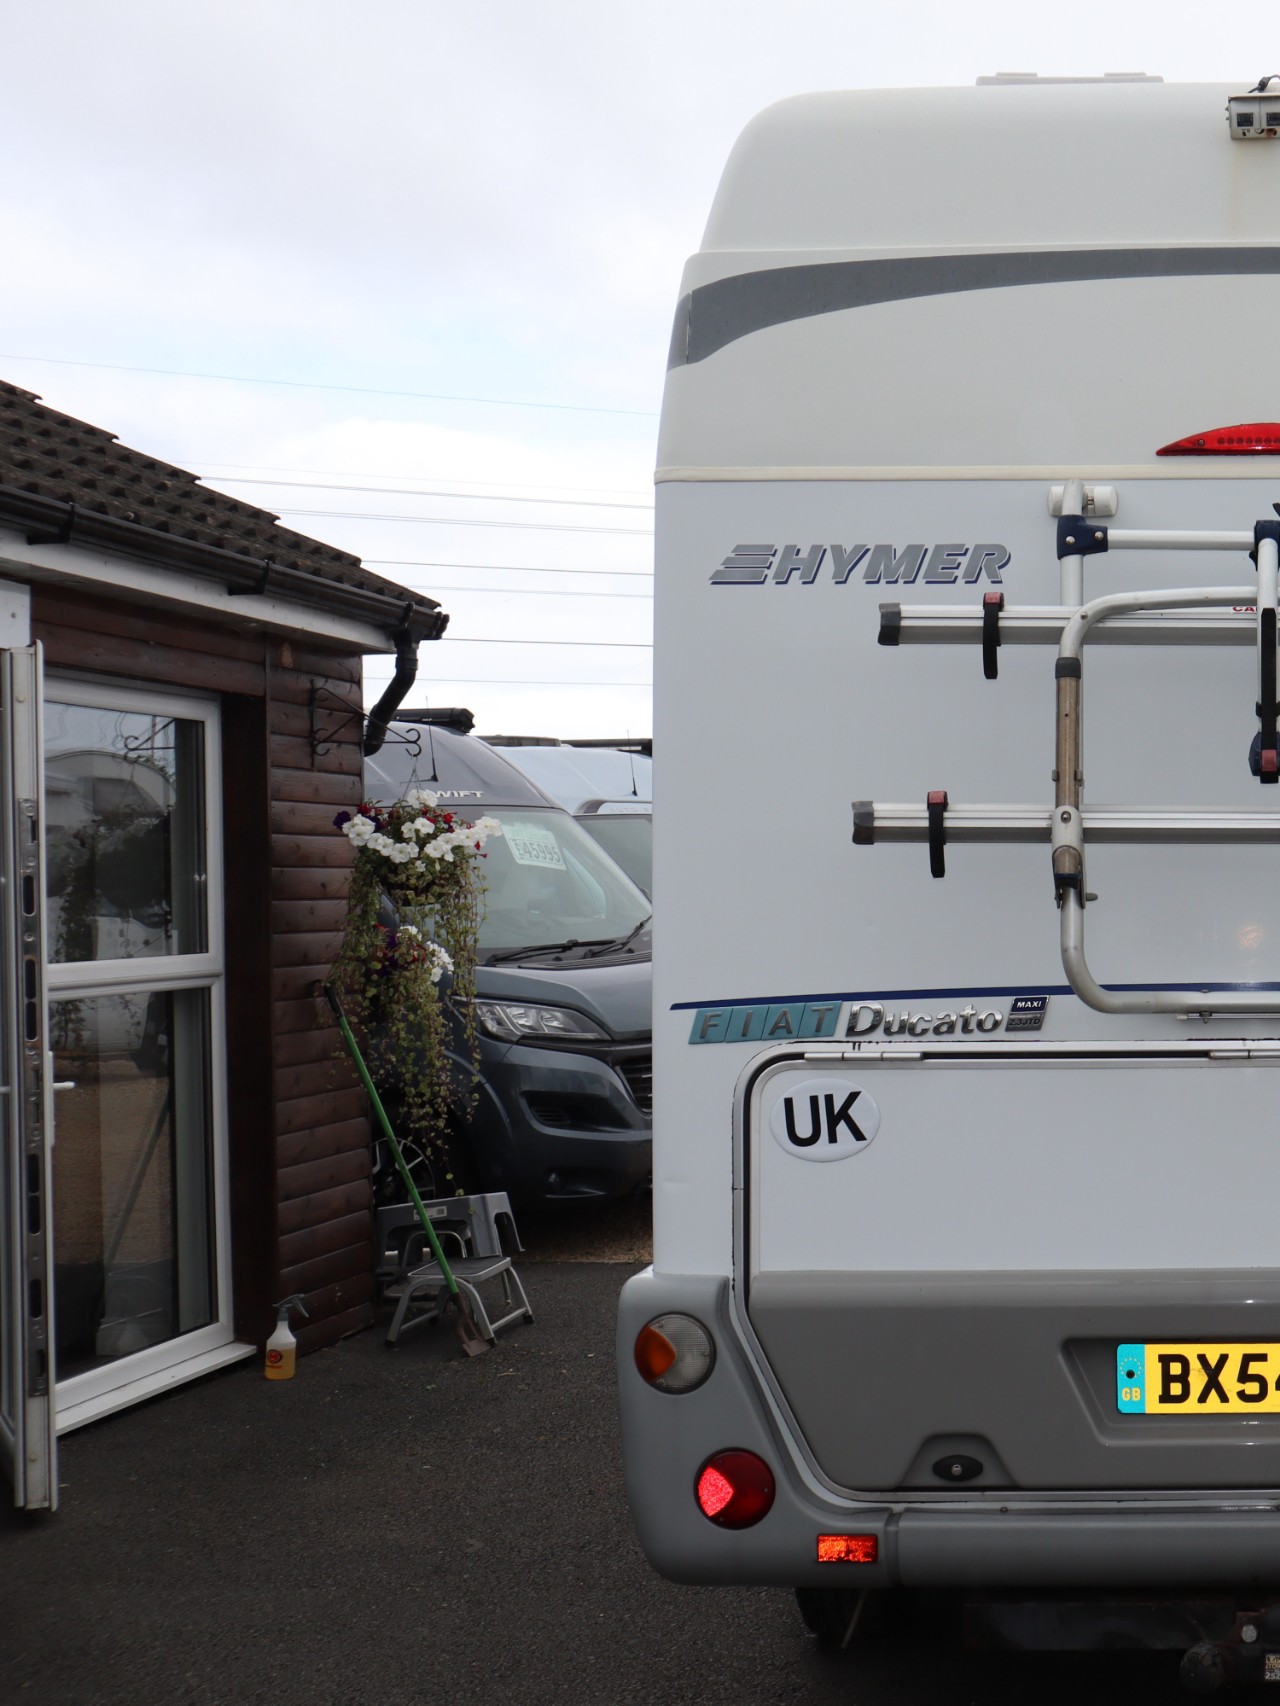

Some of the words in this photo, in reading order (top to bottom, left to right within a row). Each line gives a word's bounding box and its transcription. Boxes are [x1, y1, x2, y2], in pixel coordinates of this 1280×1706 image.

[771, 543, 1011, 585] HYMER
[434, 790, 484, 798] WIFT
[1016, 1000, 1042, 1009] MAXI
[699, 1004, 835, 1040] FIAT
[845, 1000, 1003, 1038] Ducato
[783, 1090, 868, 1148] UK
[1121, 1387, 1141, 1402] GB
